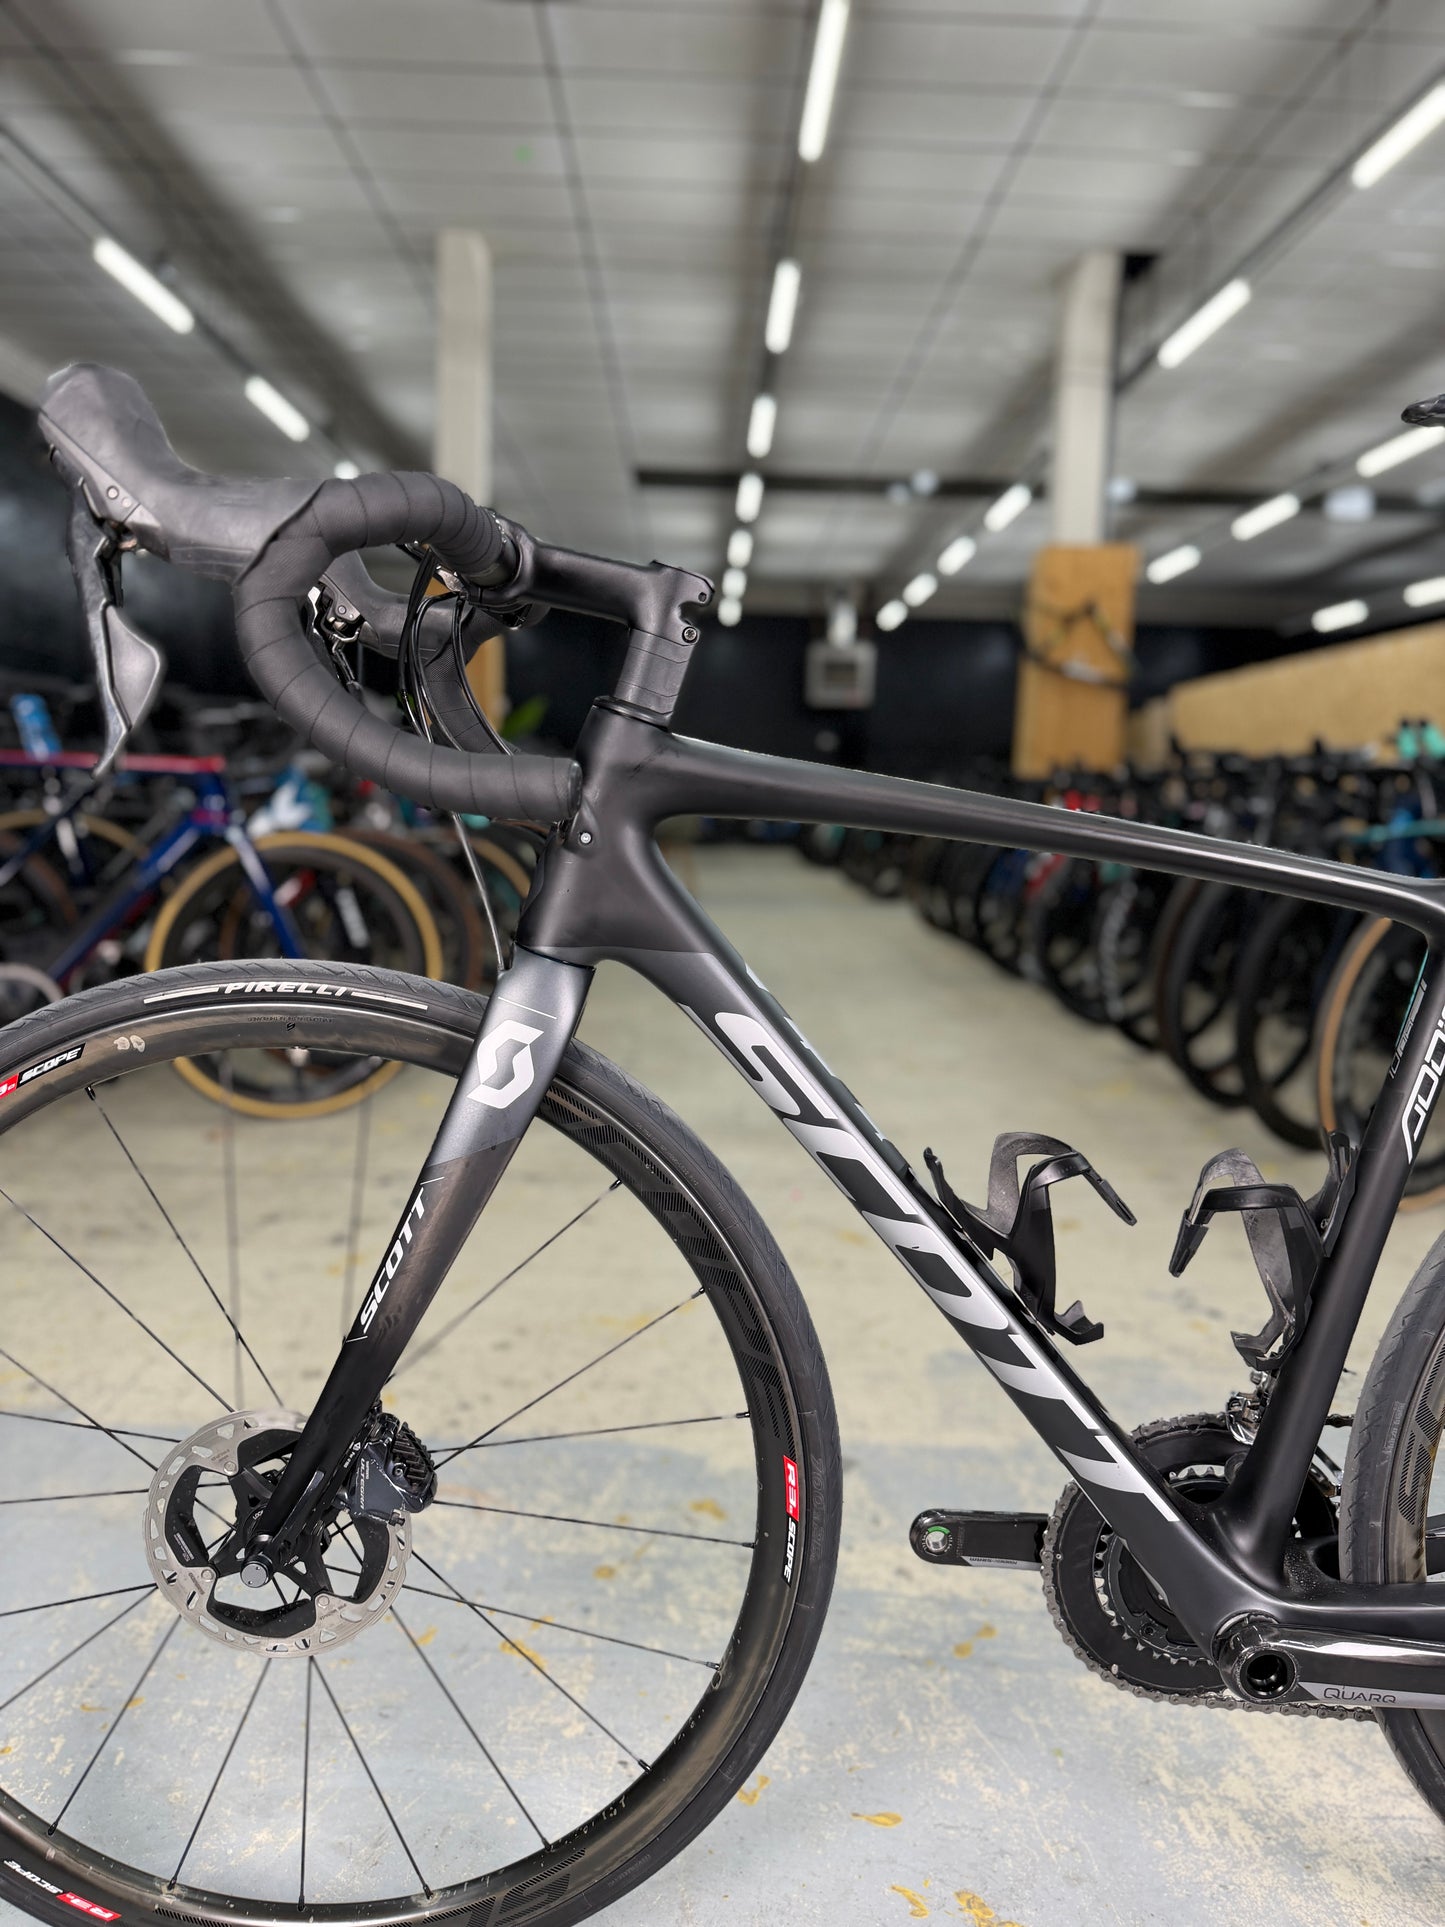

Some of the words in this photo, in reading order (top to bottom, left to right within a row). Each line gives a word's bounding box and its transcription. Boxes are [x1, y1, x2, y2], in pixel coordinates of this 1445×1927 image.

[224, 981, 347, 997] PIRELLI
[20, 1047, 82, 1084] SCOPE
[360, 1187, 425, 1334] SCOTT
[714, 1011, 1181, 1522] SCOTT
[784, 1518, 797, 1583] SCOPE
[1323, 1687, 1397, 1704] QUARQ
[3, 1859, 64, 1894] SCOPE
